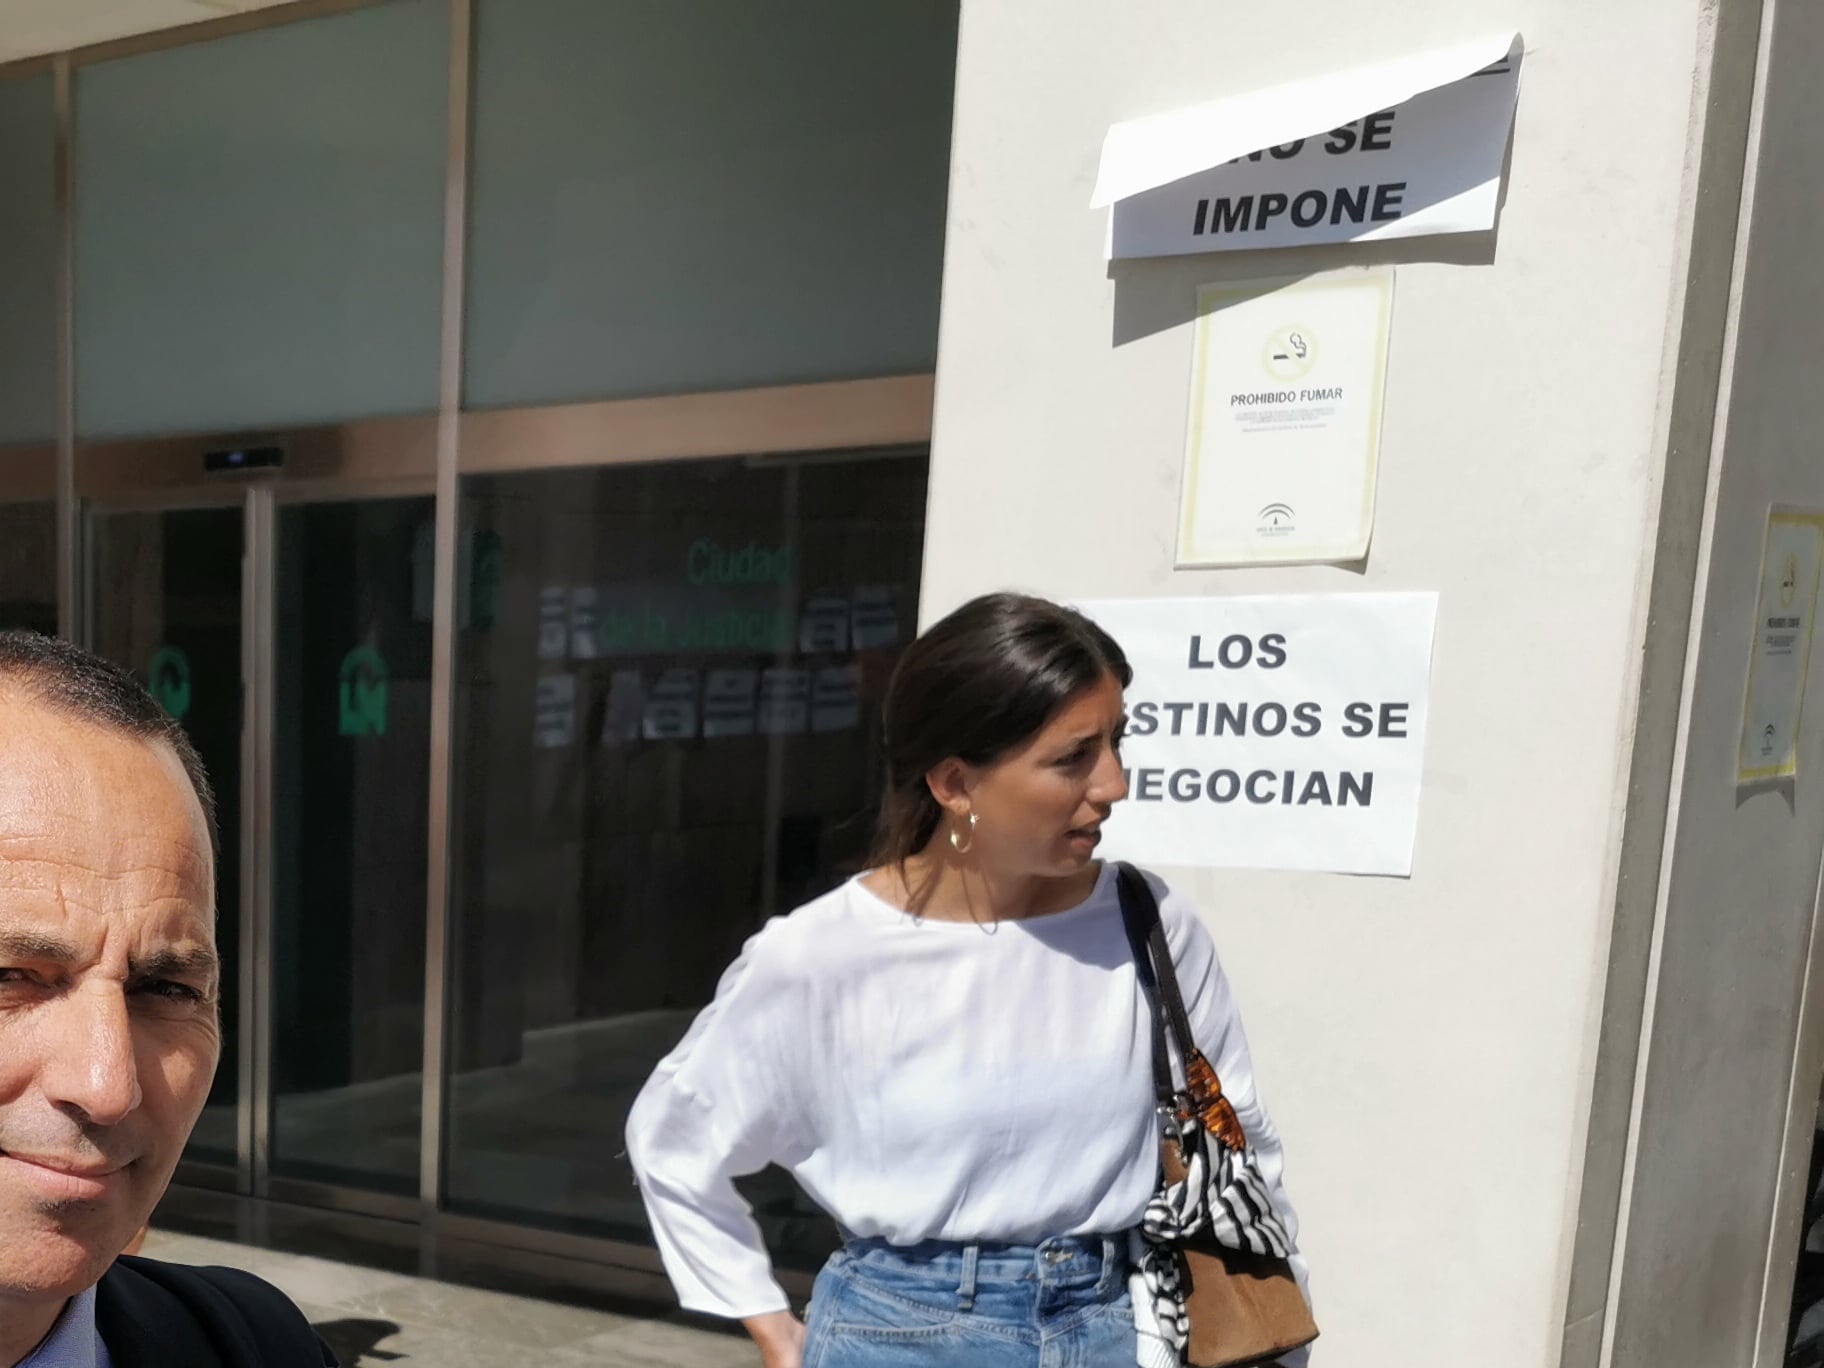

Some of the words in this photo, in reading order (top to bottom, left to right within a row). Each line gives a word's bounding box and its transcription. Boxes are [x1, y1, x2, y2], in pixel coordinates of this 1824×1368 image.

[1323, 110, 1395, 155] SE
[1193, 182, 1406, 236] IMPONE
[1231, 390, 1296, 406] PROHIBIDO
[1300, 387, 1343, 402] FUMAR
[687, 537, 793, 585] Ciudad
[1188, 634, 1287, 669] LOS
[1122, 702, 1322, 738] STINOS
[1341, 702, 1409, 738] SE
[1126, 768, 1374, 807] EGOCIAN
